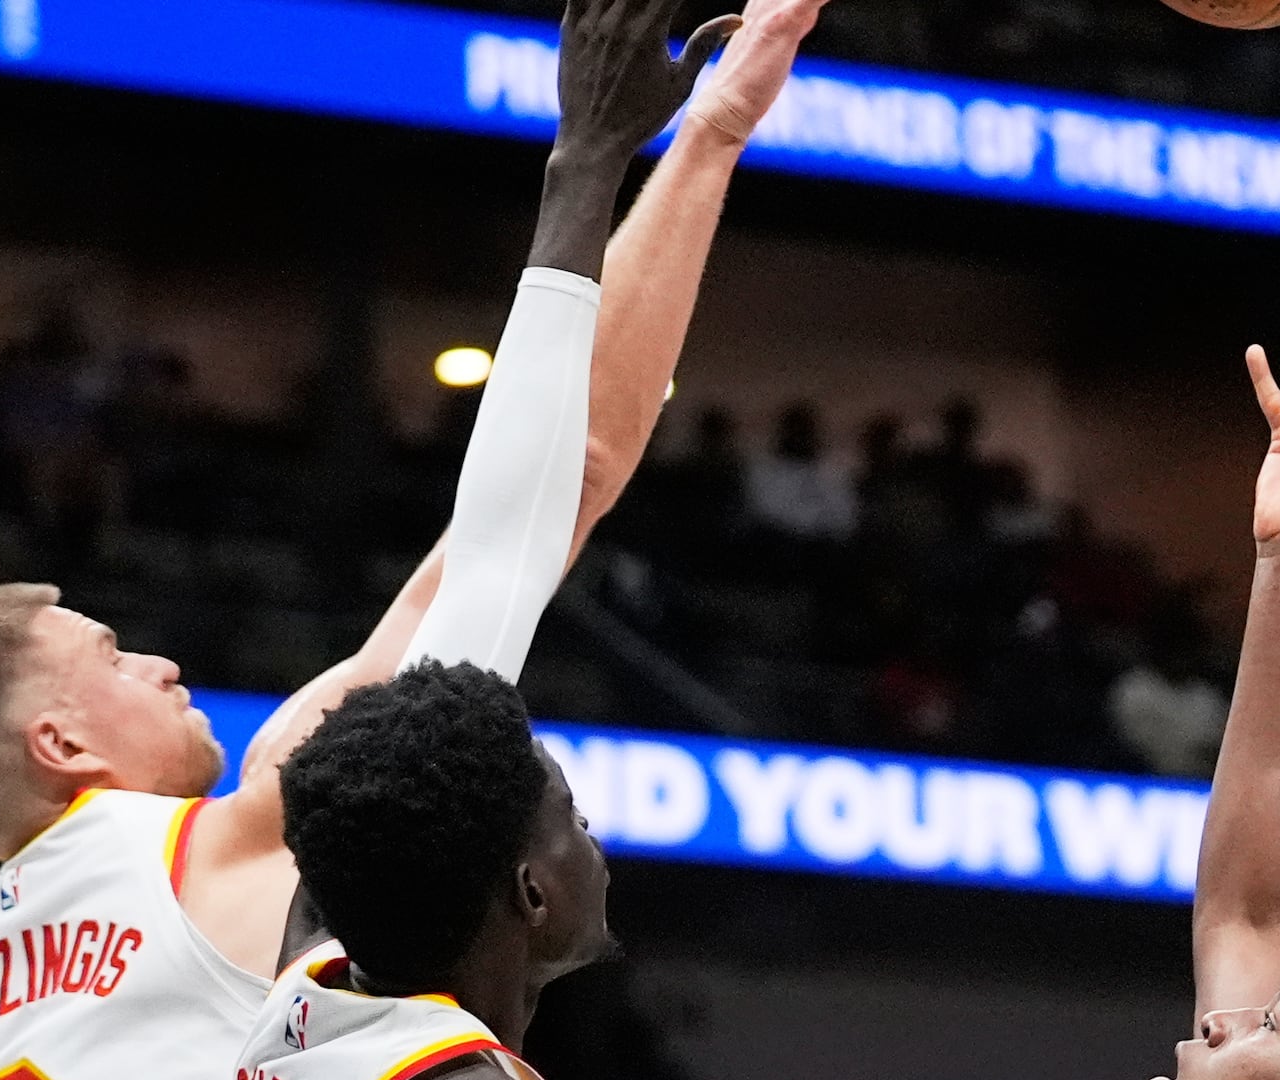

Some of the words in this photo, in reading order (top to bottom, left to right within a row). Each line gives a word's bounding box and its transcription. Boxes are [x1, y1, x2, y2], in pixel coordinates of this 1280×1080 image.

[1053, 108, 1163, 199] THE
[533, 732, 711, 847] ND
[711, 747, 1043, 882] YOUR
